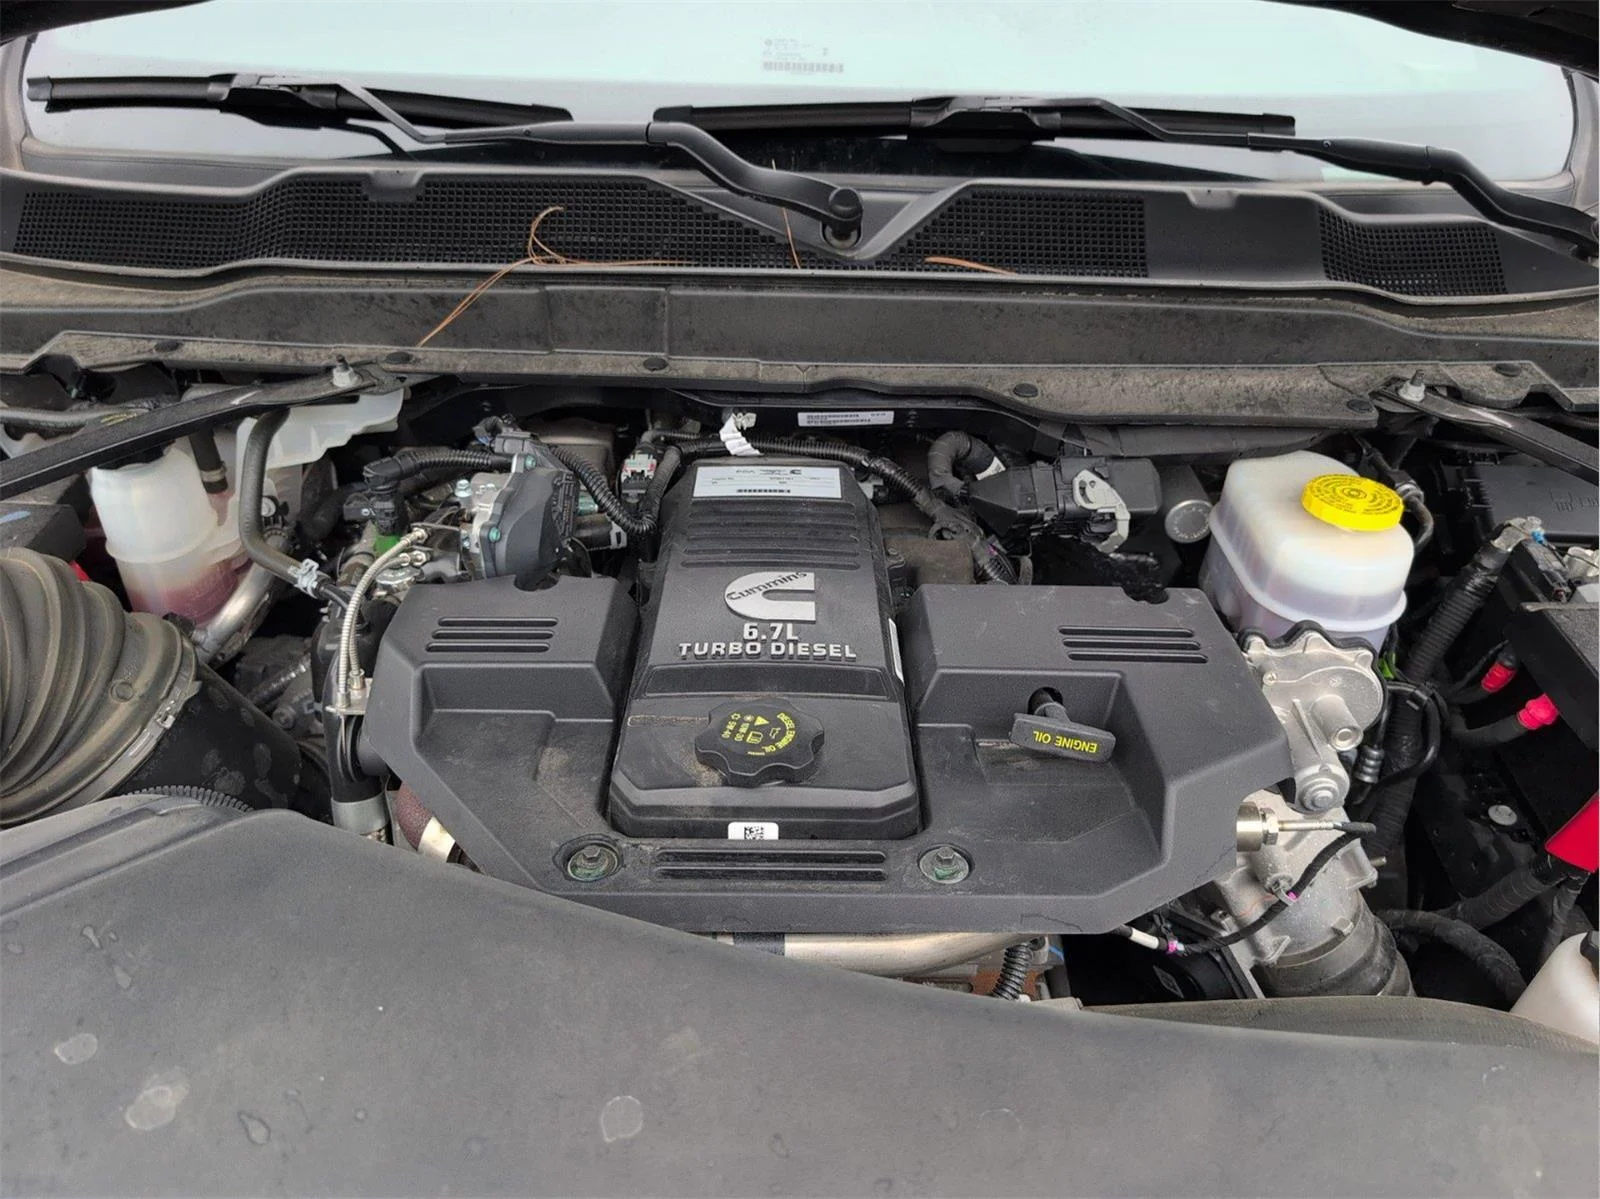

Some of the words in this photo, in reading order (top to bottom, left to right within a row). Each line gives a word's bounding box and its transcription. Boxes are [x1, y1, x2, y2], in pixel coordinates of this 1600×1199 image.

[726, 571, 807, 601] Cummins
[743, 622, 798, 641] 6.7L
[679, 642, 761, 659] TURBO
[771, 641, 857, 660] DIESEL
[1033, 730, 1052, 744] OIL
[1055, 735, 1097, 753] ENGINE
